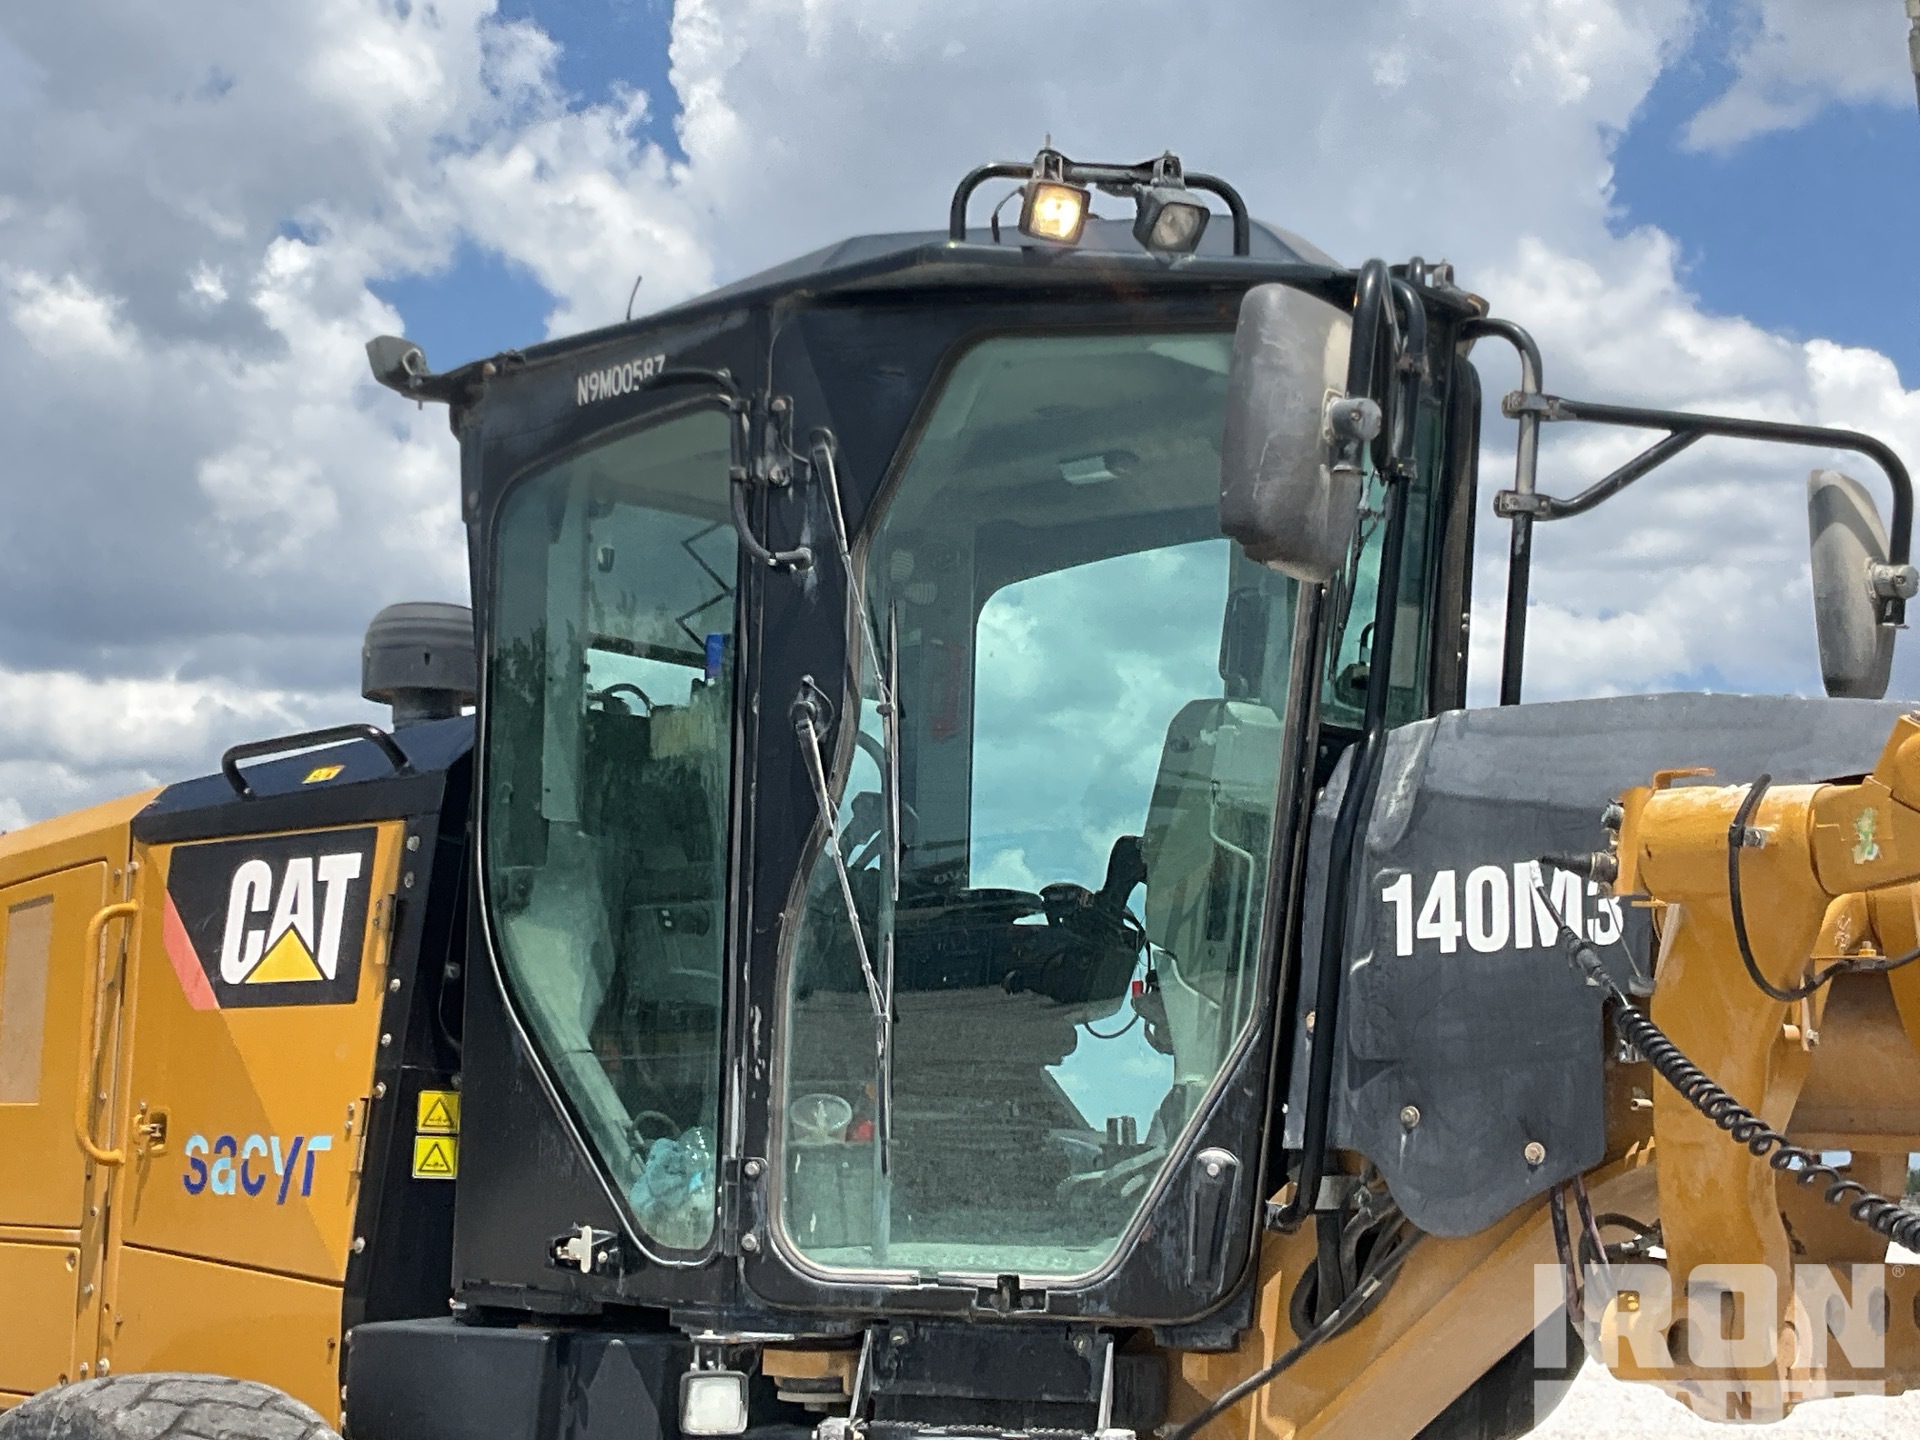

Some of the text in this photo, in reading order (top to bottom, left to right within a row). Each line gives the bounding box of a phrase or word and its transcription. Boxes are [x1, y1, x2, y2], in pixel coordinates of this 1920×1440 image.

[220, 852, 363, 985] CAT
[1382, 859, 1625, 956] 140M3
[183, 1134, 333, 1206] sacyr
